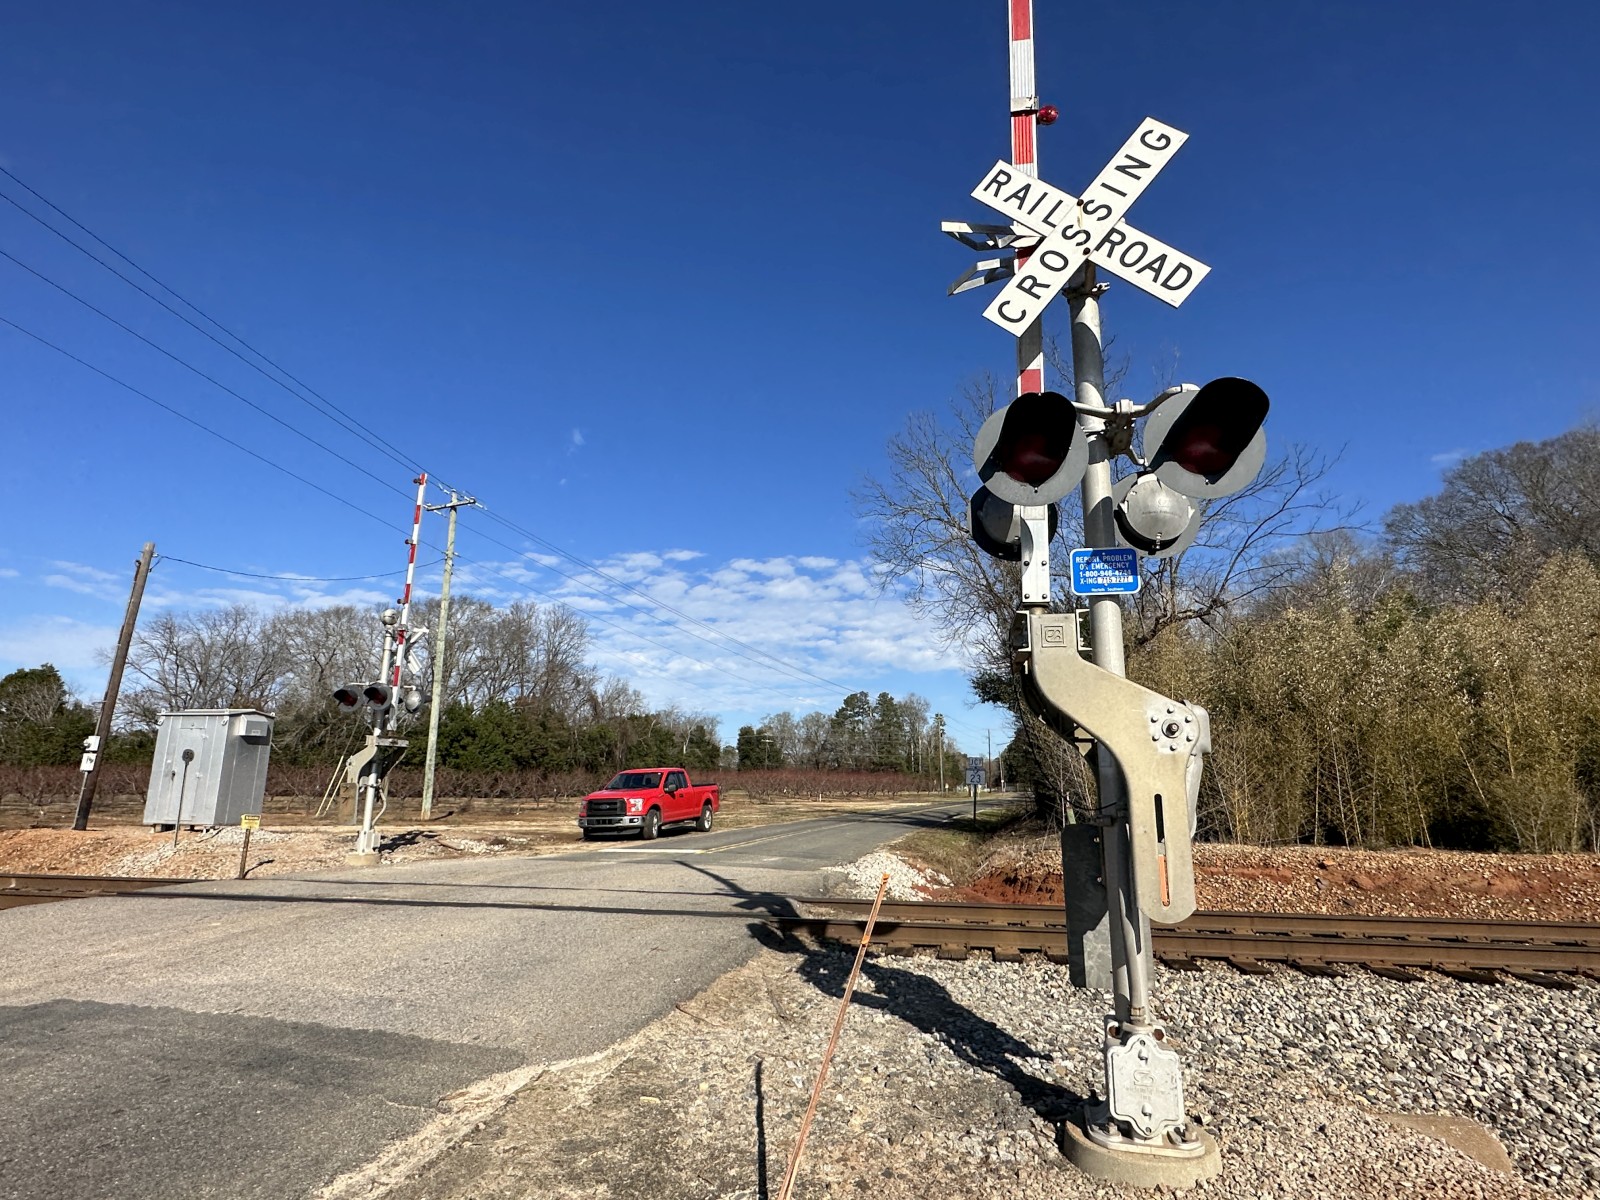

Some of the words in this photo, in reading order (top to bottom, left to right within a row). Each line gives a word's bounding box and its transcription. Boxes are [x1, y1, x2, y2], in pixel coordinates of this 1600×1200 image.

[982, 168, 1064, 229] RAIL
[997, 129, 1171, 324] CROSSING
[1094, 227, 1193, 291] ROAD
[1091, 562, 1129, 570] EMERGENCY
[970, 774, 981, 783] 23
